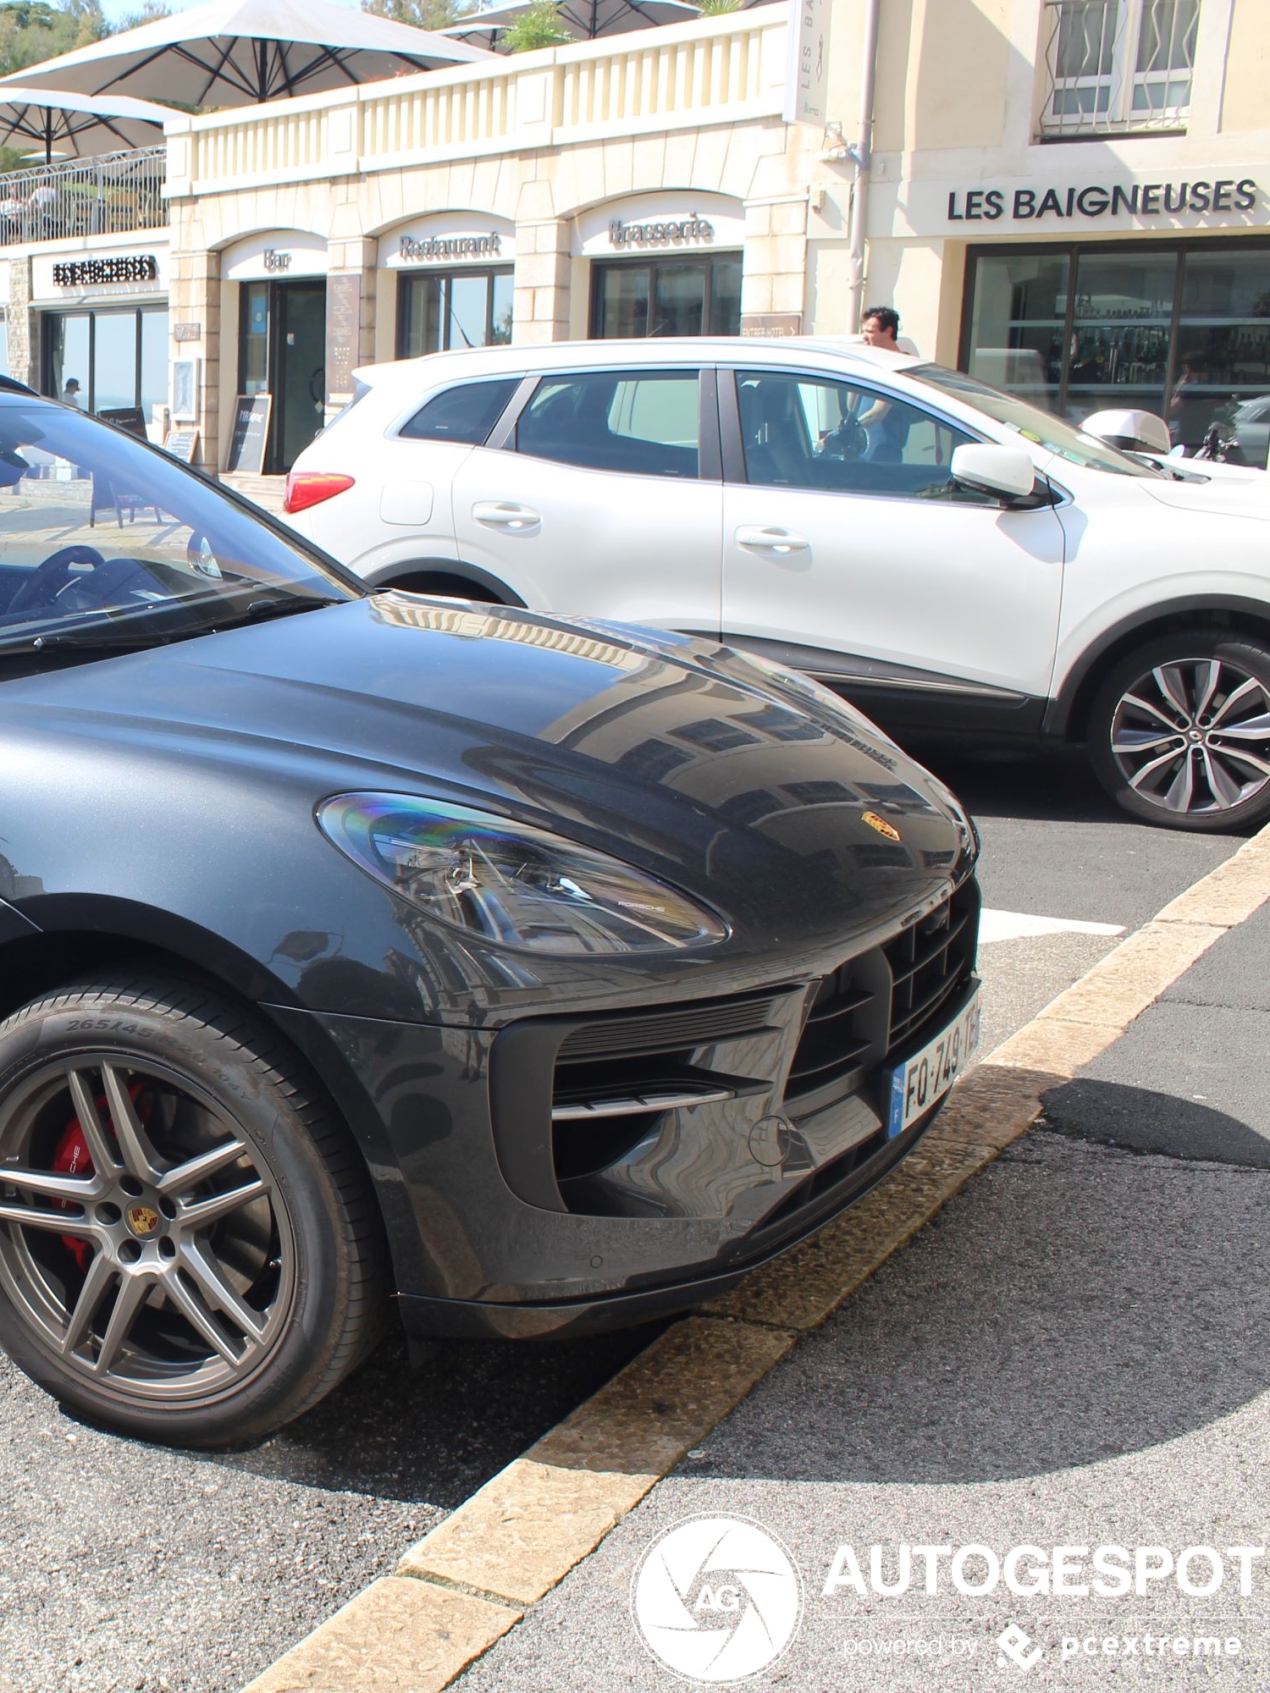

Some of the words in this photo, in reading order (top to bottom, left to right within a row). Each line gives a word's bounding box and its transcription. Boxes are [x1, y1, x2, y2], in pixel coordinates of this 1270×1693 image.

[801, 46, 812, 89] LES
[947, 190, 1004, 220] LES
[1012, 179, 1257, 220] BAIGNEUSES
[399, 231, 501, 259] Restaurant
[608, 211, 714, 246] Brasserie
[263, 248, 292, 271] Bar
[617, 901, 666, 912] PORSCHE
[65, 1019, 155, 1038] 265/45
[158, 1036, 208, 1063] R20
